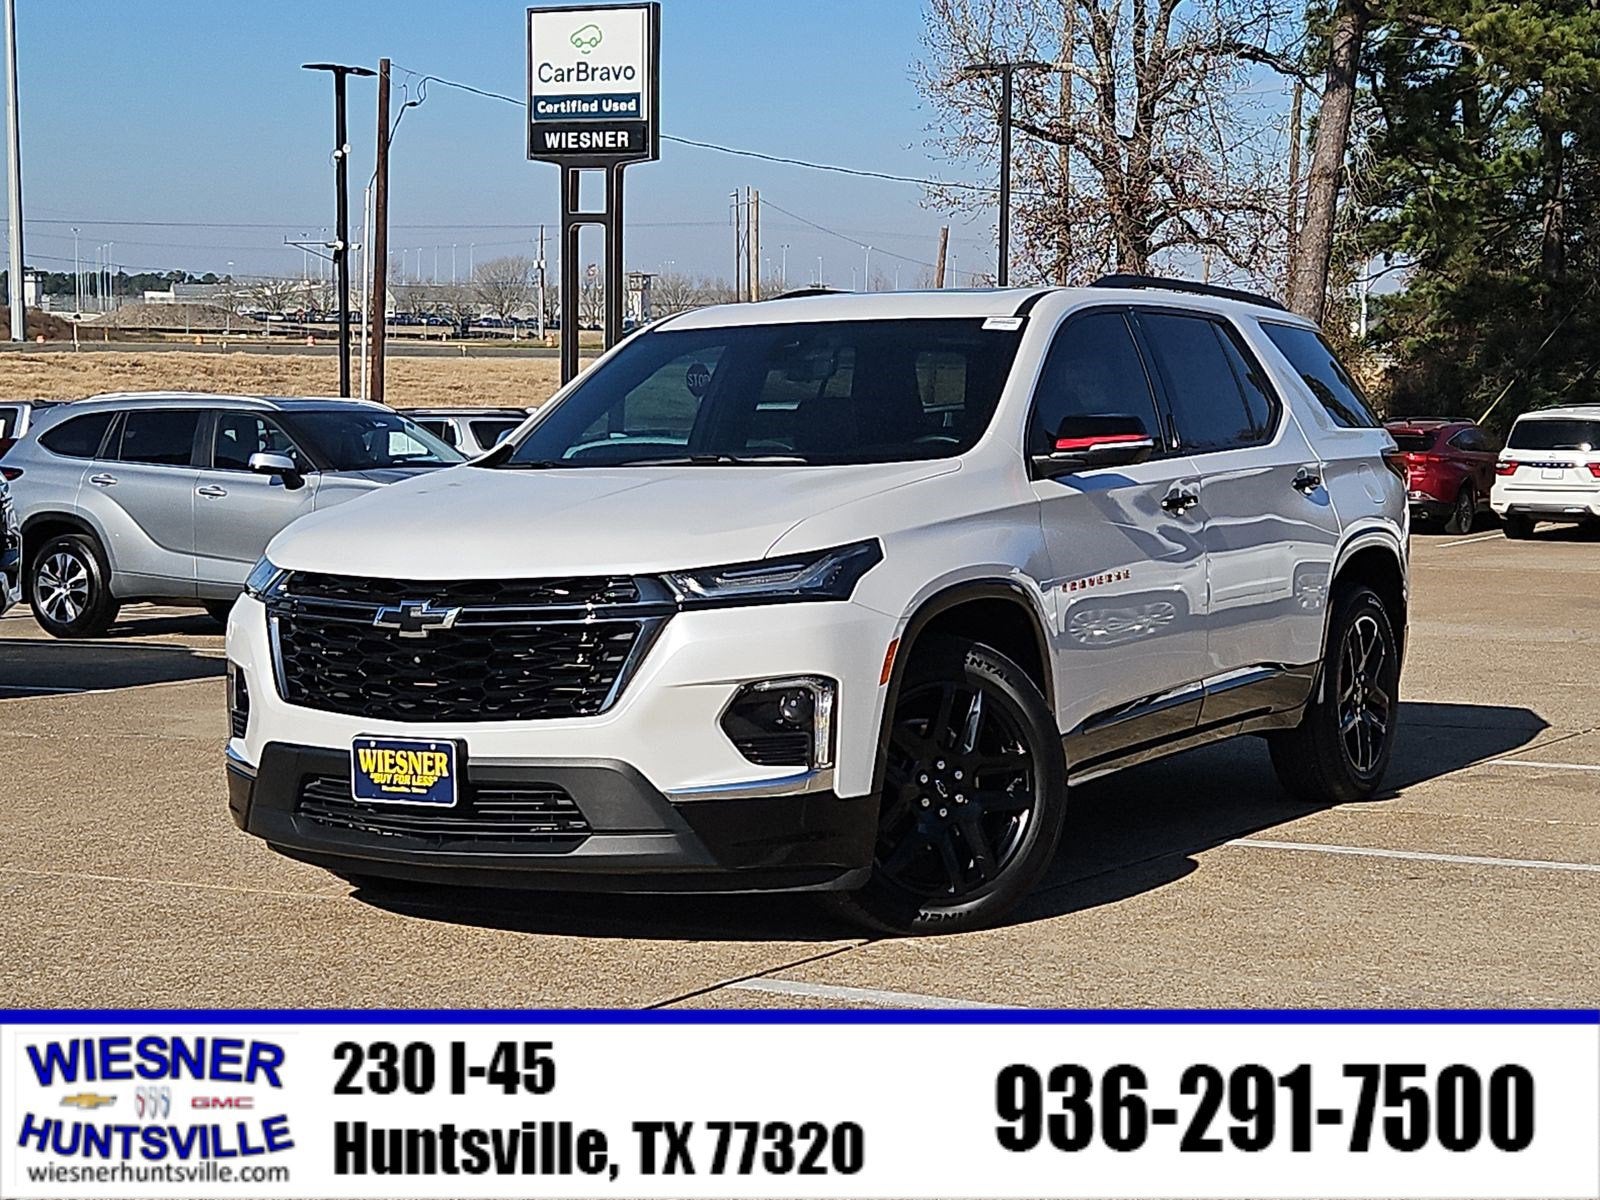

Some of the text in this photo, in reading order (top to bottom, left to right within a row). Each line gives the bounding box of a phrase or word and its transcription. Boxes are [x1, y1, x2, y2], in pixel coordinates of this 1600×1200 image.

[538, 61, 636, 83] CarBravo
[537, 98, 637, 114] Certified Used
[544, 131, 630, 149] WIESNER
[358, 748, 450, 777] WIESNER
